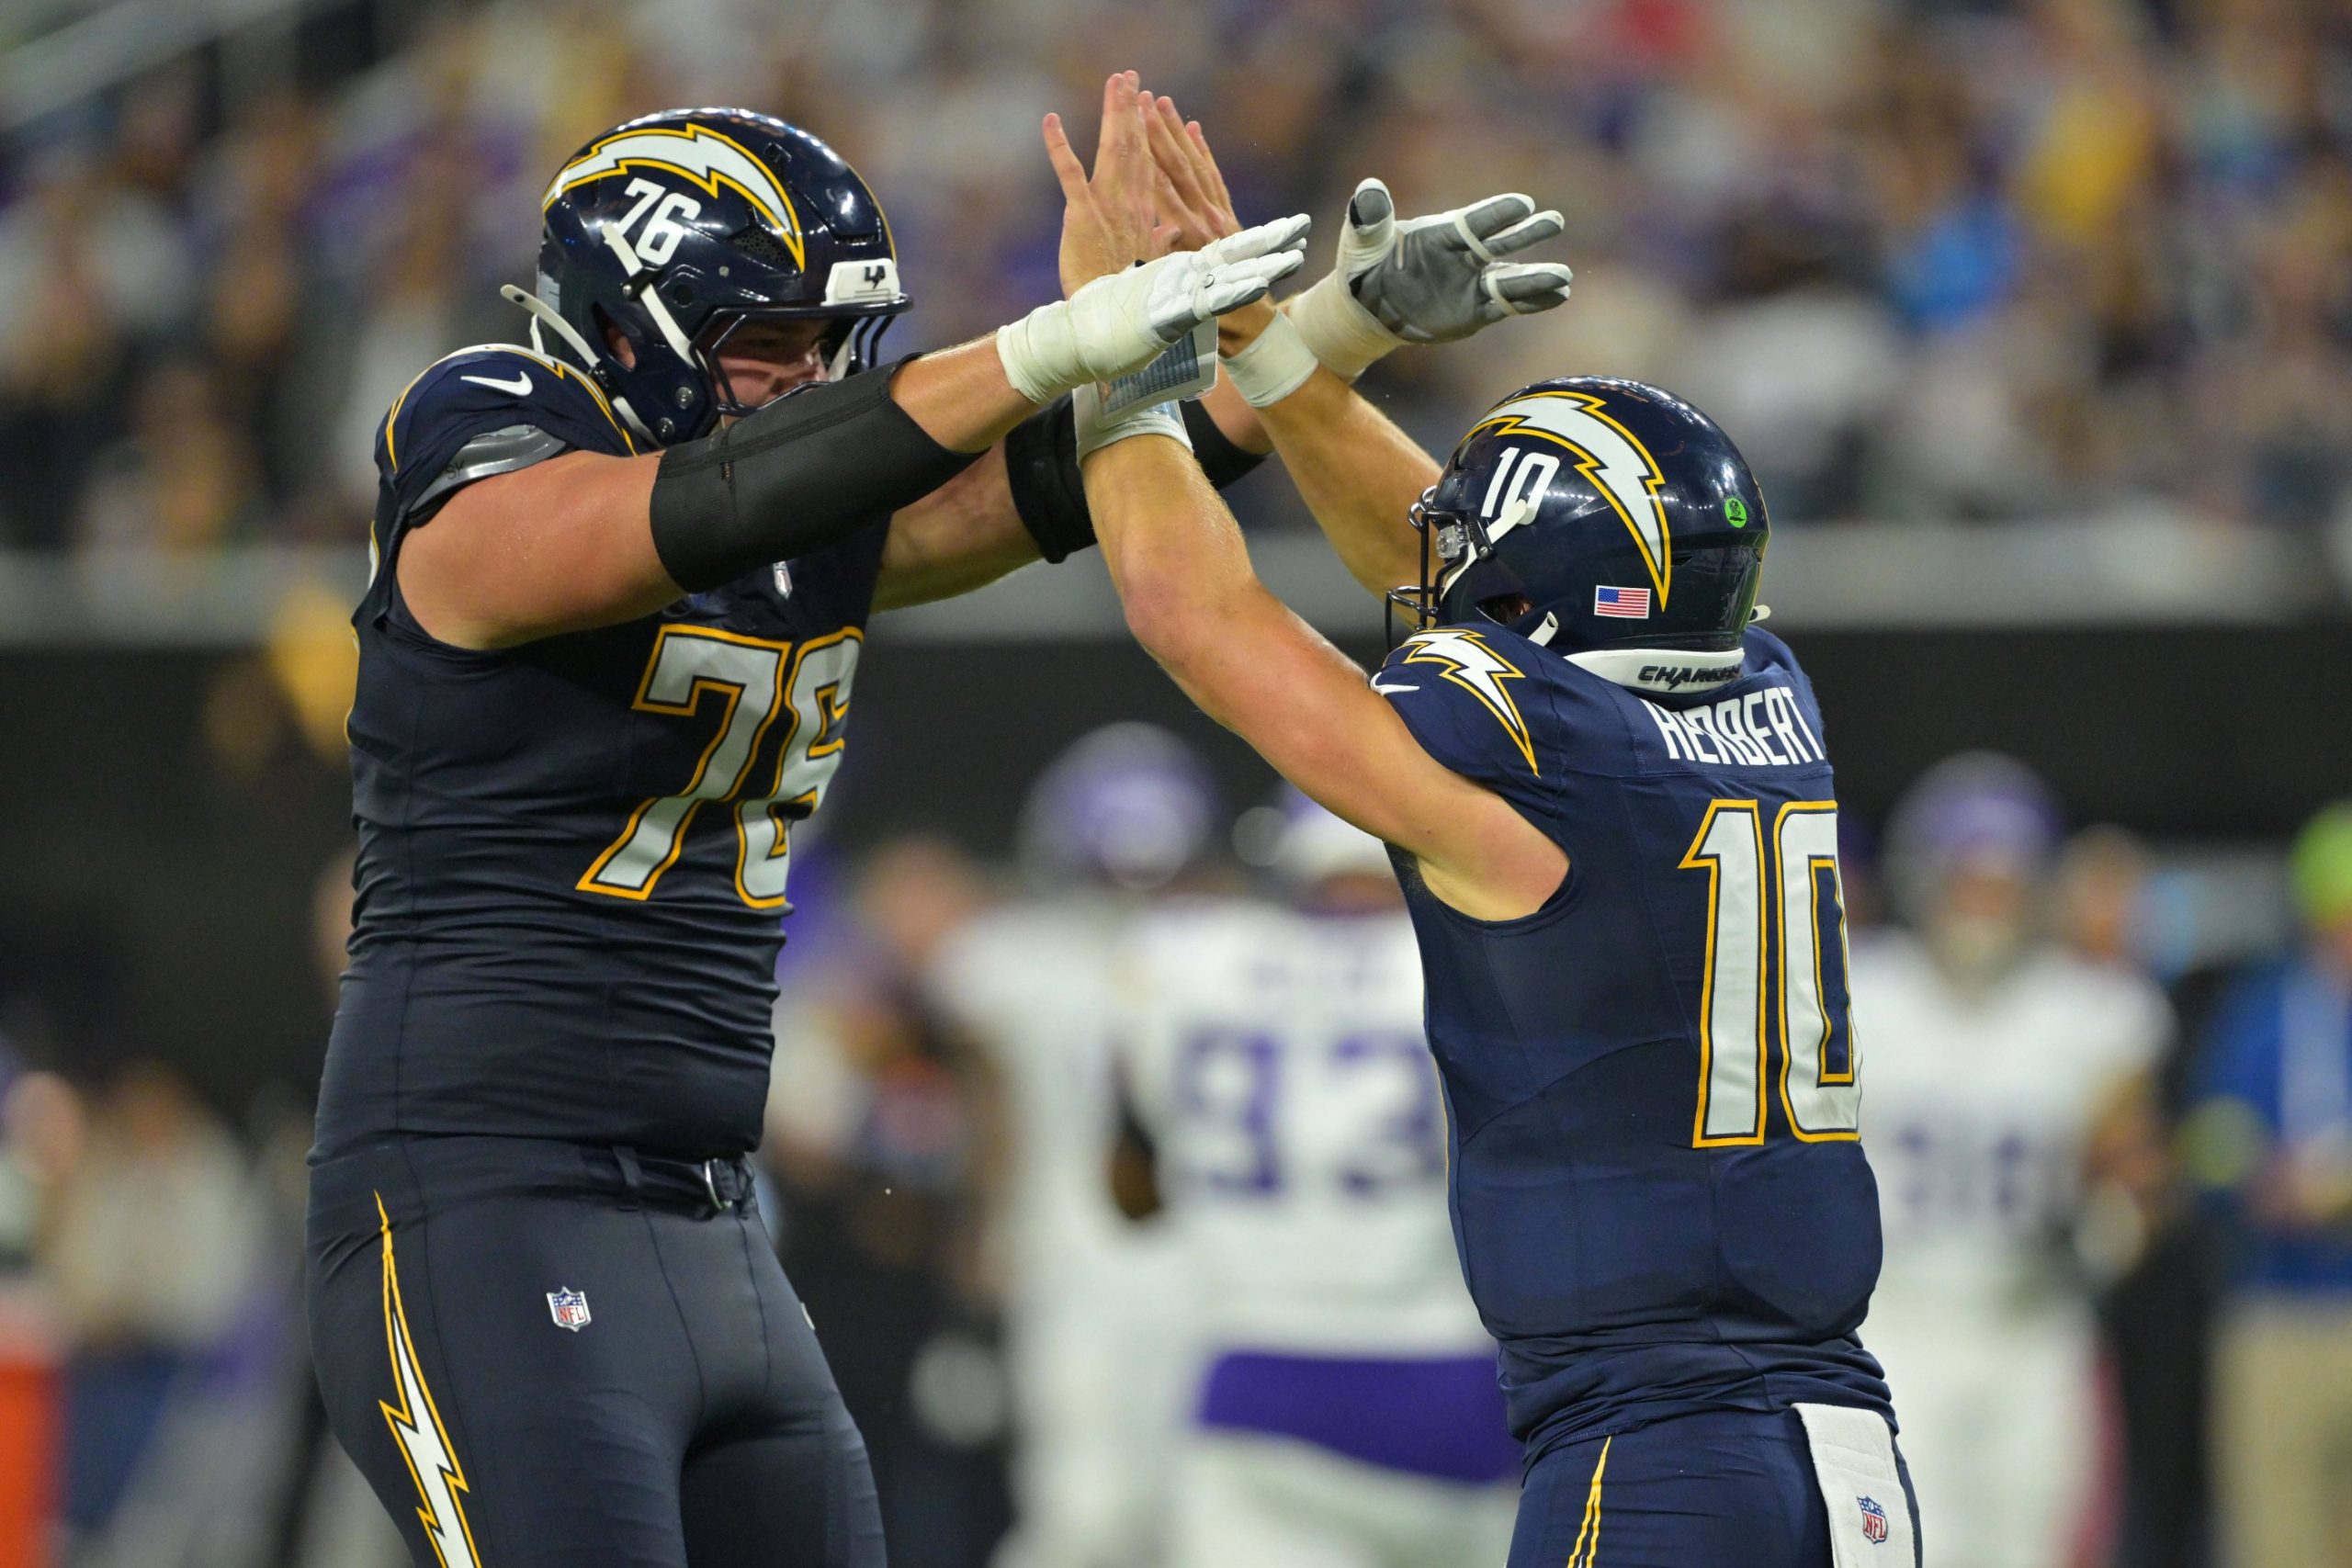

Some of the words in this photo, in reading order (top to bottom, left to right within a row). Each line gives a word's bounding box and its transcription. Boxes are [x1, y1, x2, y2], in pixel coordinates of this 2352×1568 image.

[617, 177, 702, 265] 76
[1480, 446, 1560, 525] 10
[575, 623, 865, 909] 76
[1639, 686, 1825, 766] HERBERT
[1678, 798, 1864, 1148] 10
[559, 1307, 584, 1323] NFL
[1864, 1514, 1885, 1539] NFL
